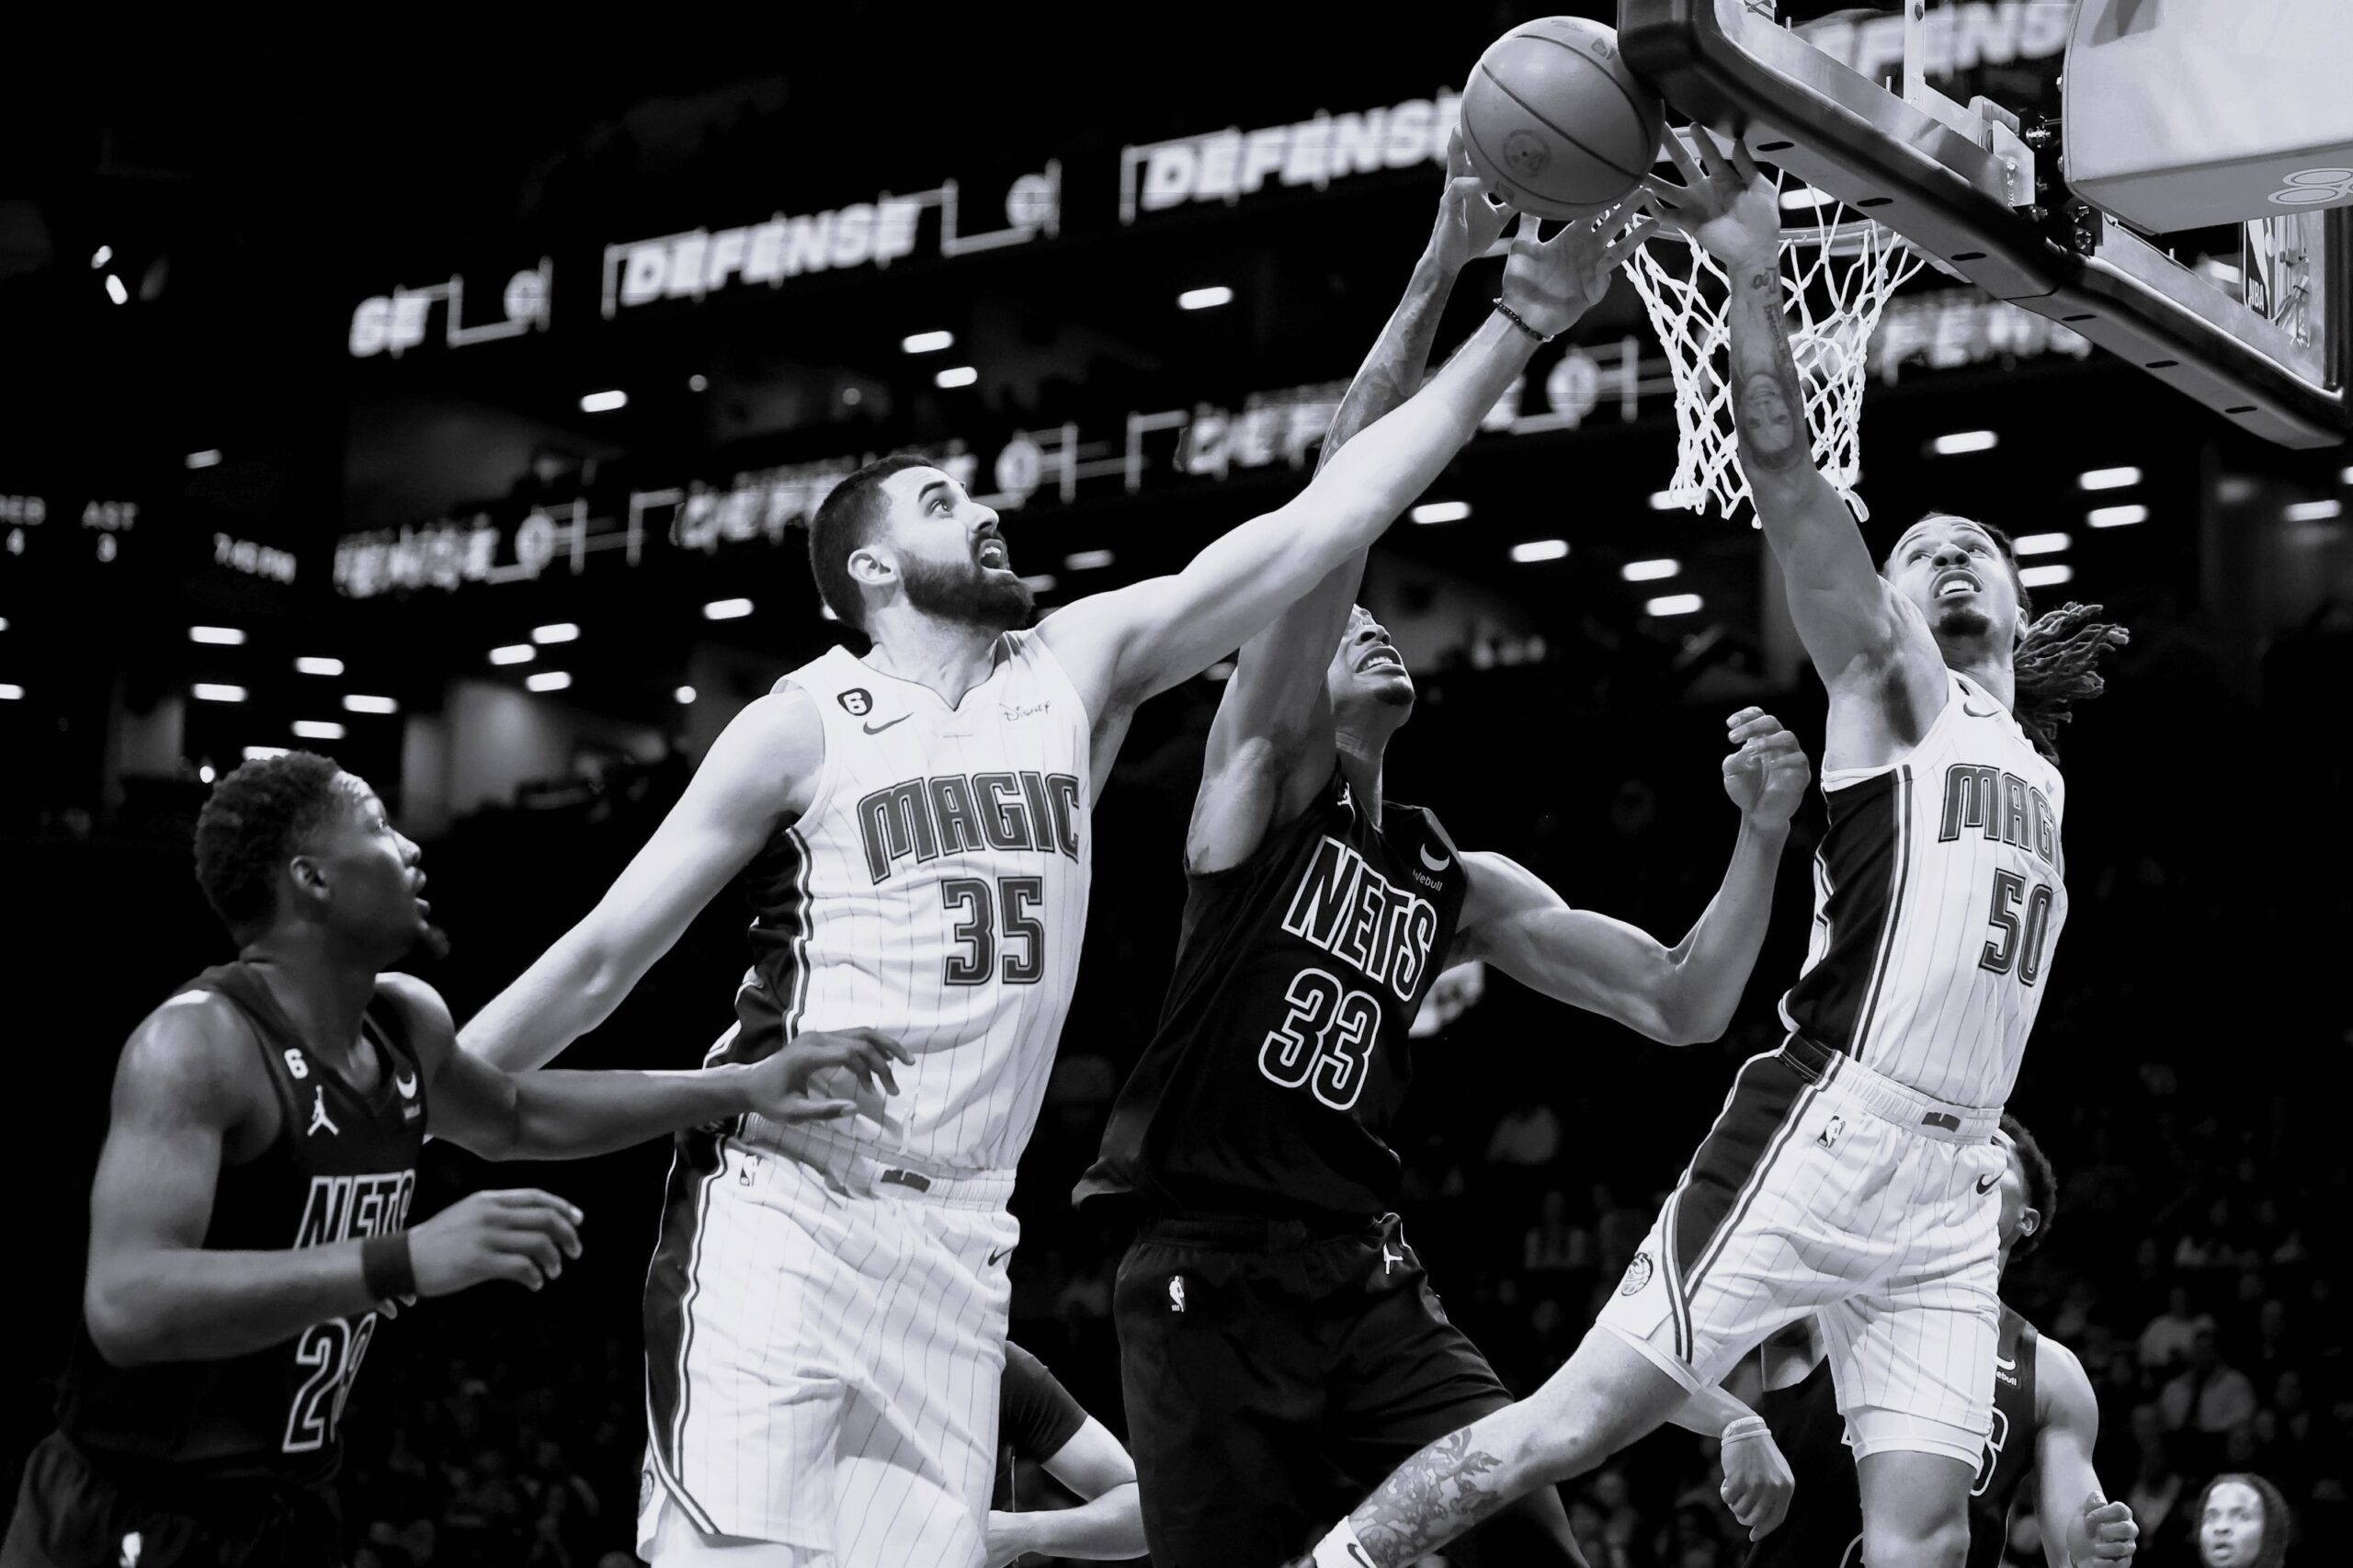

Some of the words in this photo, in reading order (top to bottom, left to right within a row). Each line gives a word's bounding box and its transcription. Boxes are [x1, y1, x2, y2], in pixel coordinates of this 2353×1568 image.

[620, 197, 921, 307] DEFENSE
[2248, 277, 2265, 312] NBA
[82, 500, 139, 531] AST
[842, 690, 869, 715] 6
[857, 770, 1080, 884] MAGIC
[1413, 869, 1444, 892] Webull
[941, 877, 1045, 986] 35
[1280, 835, 1438, 1002] NETS
[1978, 868, 2052, 988] 50
[284, 1048, 309, 1079] 6
[1258, 968, 1382, 1111] 33
